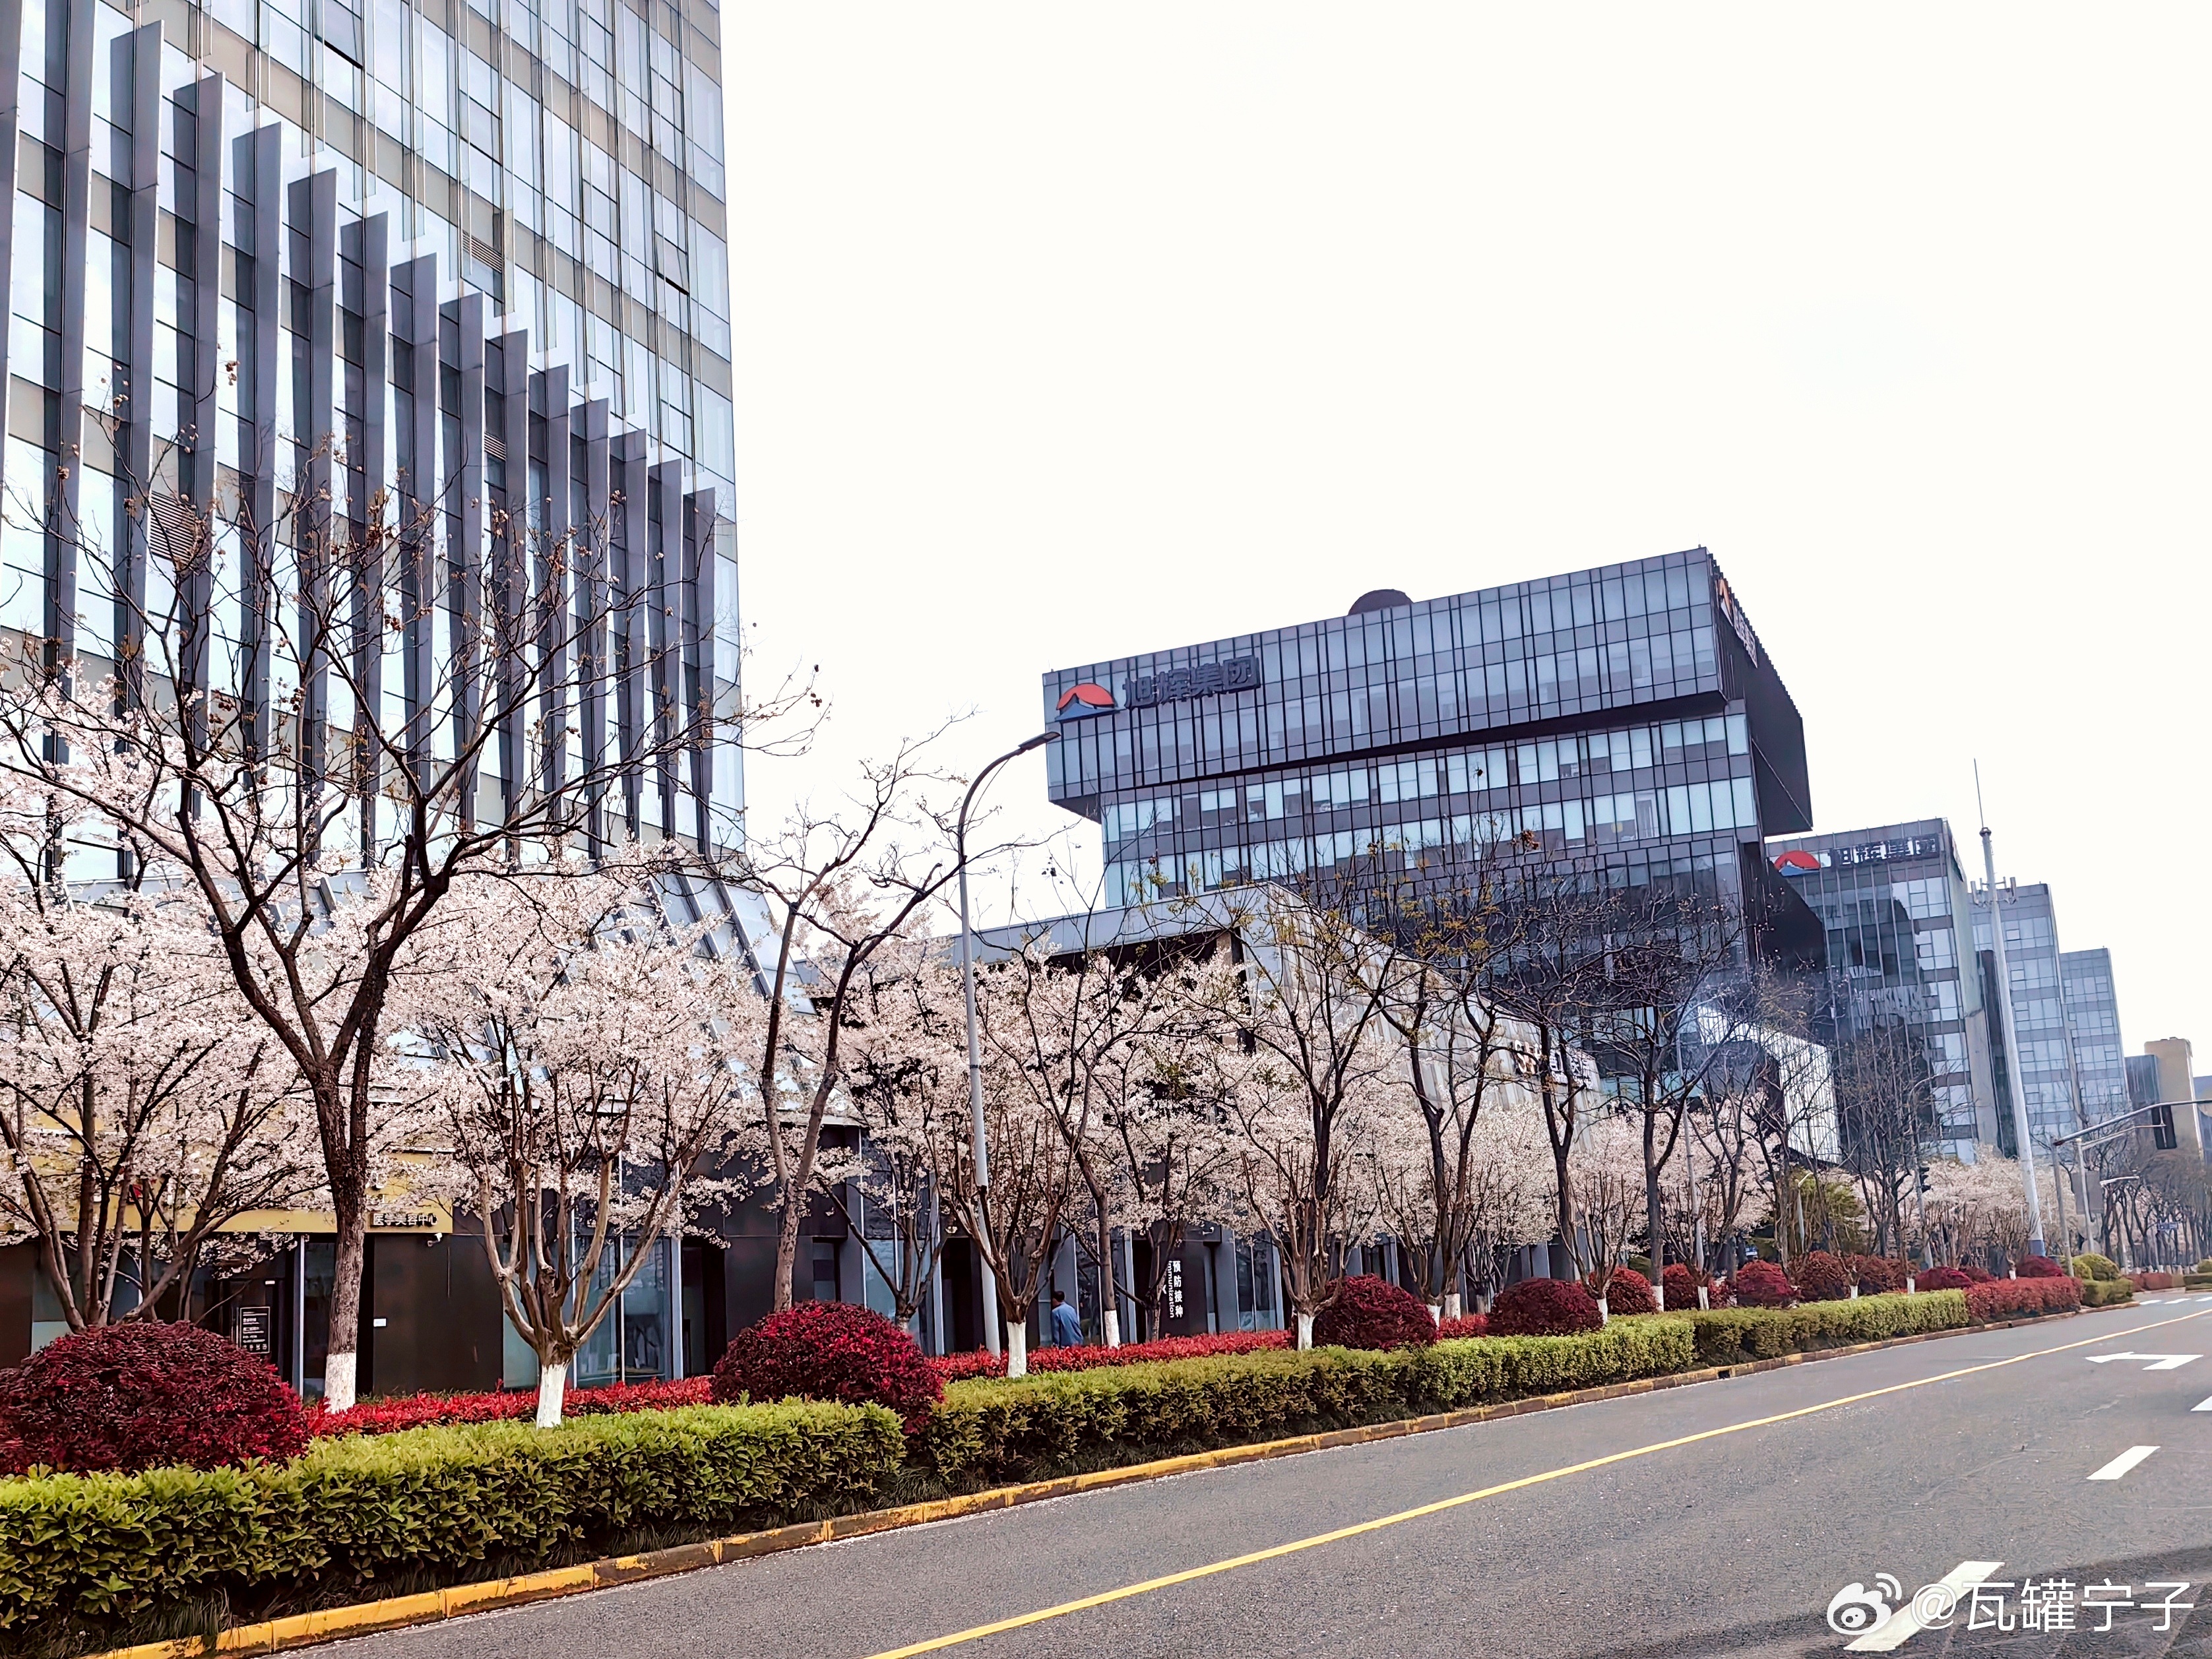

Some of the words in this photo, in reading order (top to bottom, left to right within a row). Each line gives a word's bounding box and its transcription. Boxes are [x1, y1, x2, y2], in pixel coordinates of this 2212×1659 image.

[373, 1213, 437, 1226] 医学美容中心
[1173, 1261, 1183, 1317] 预防接种
